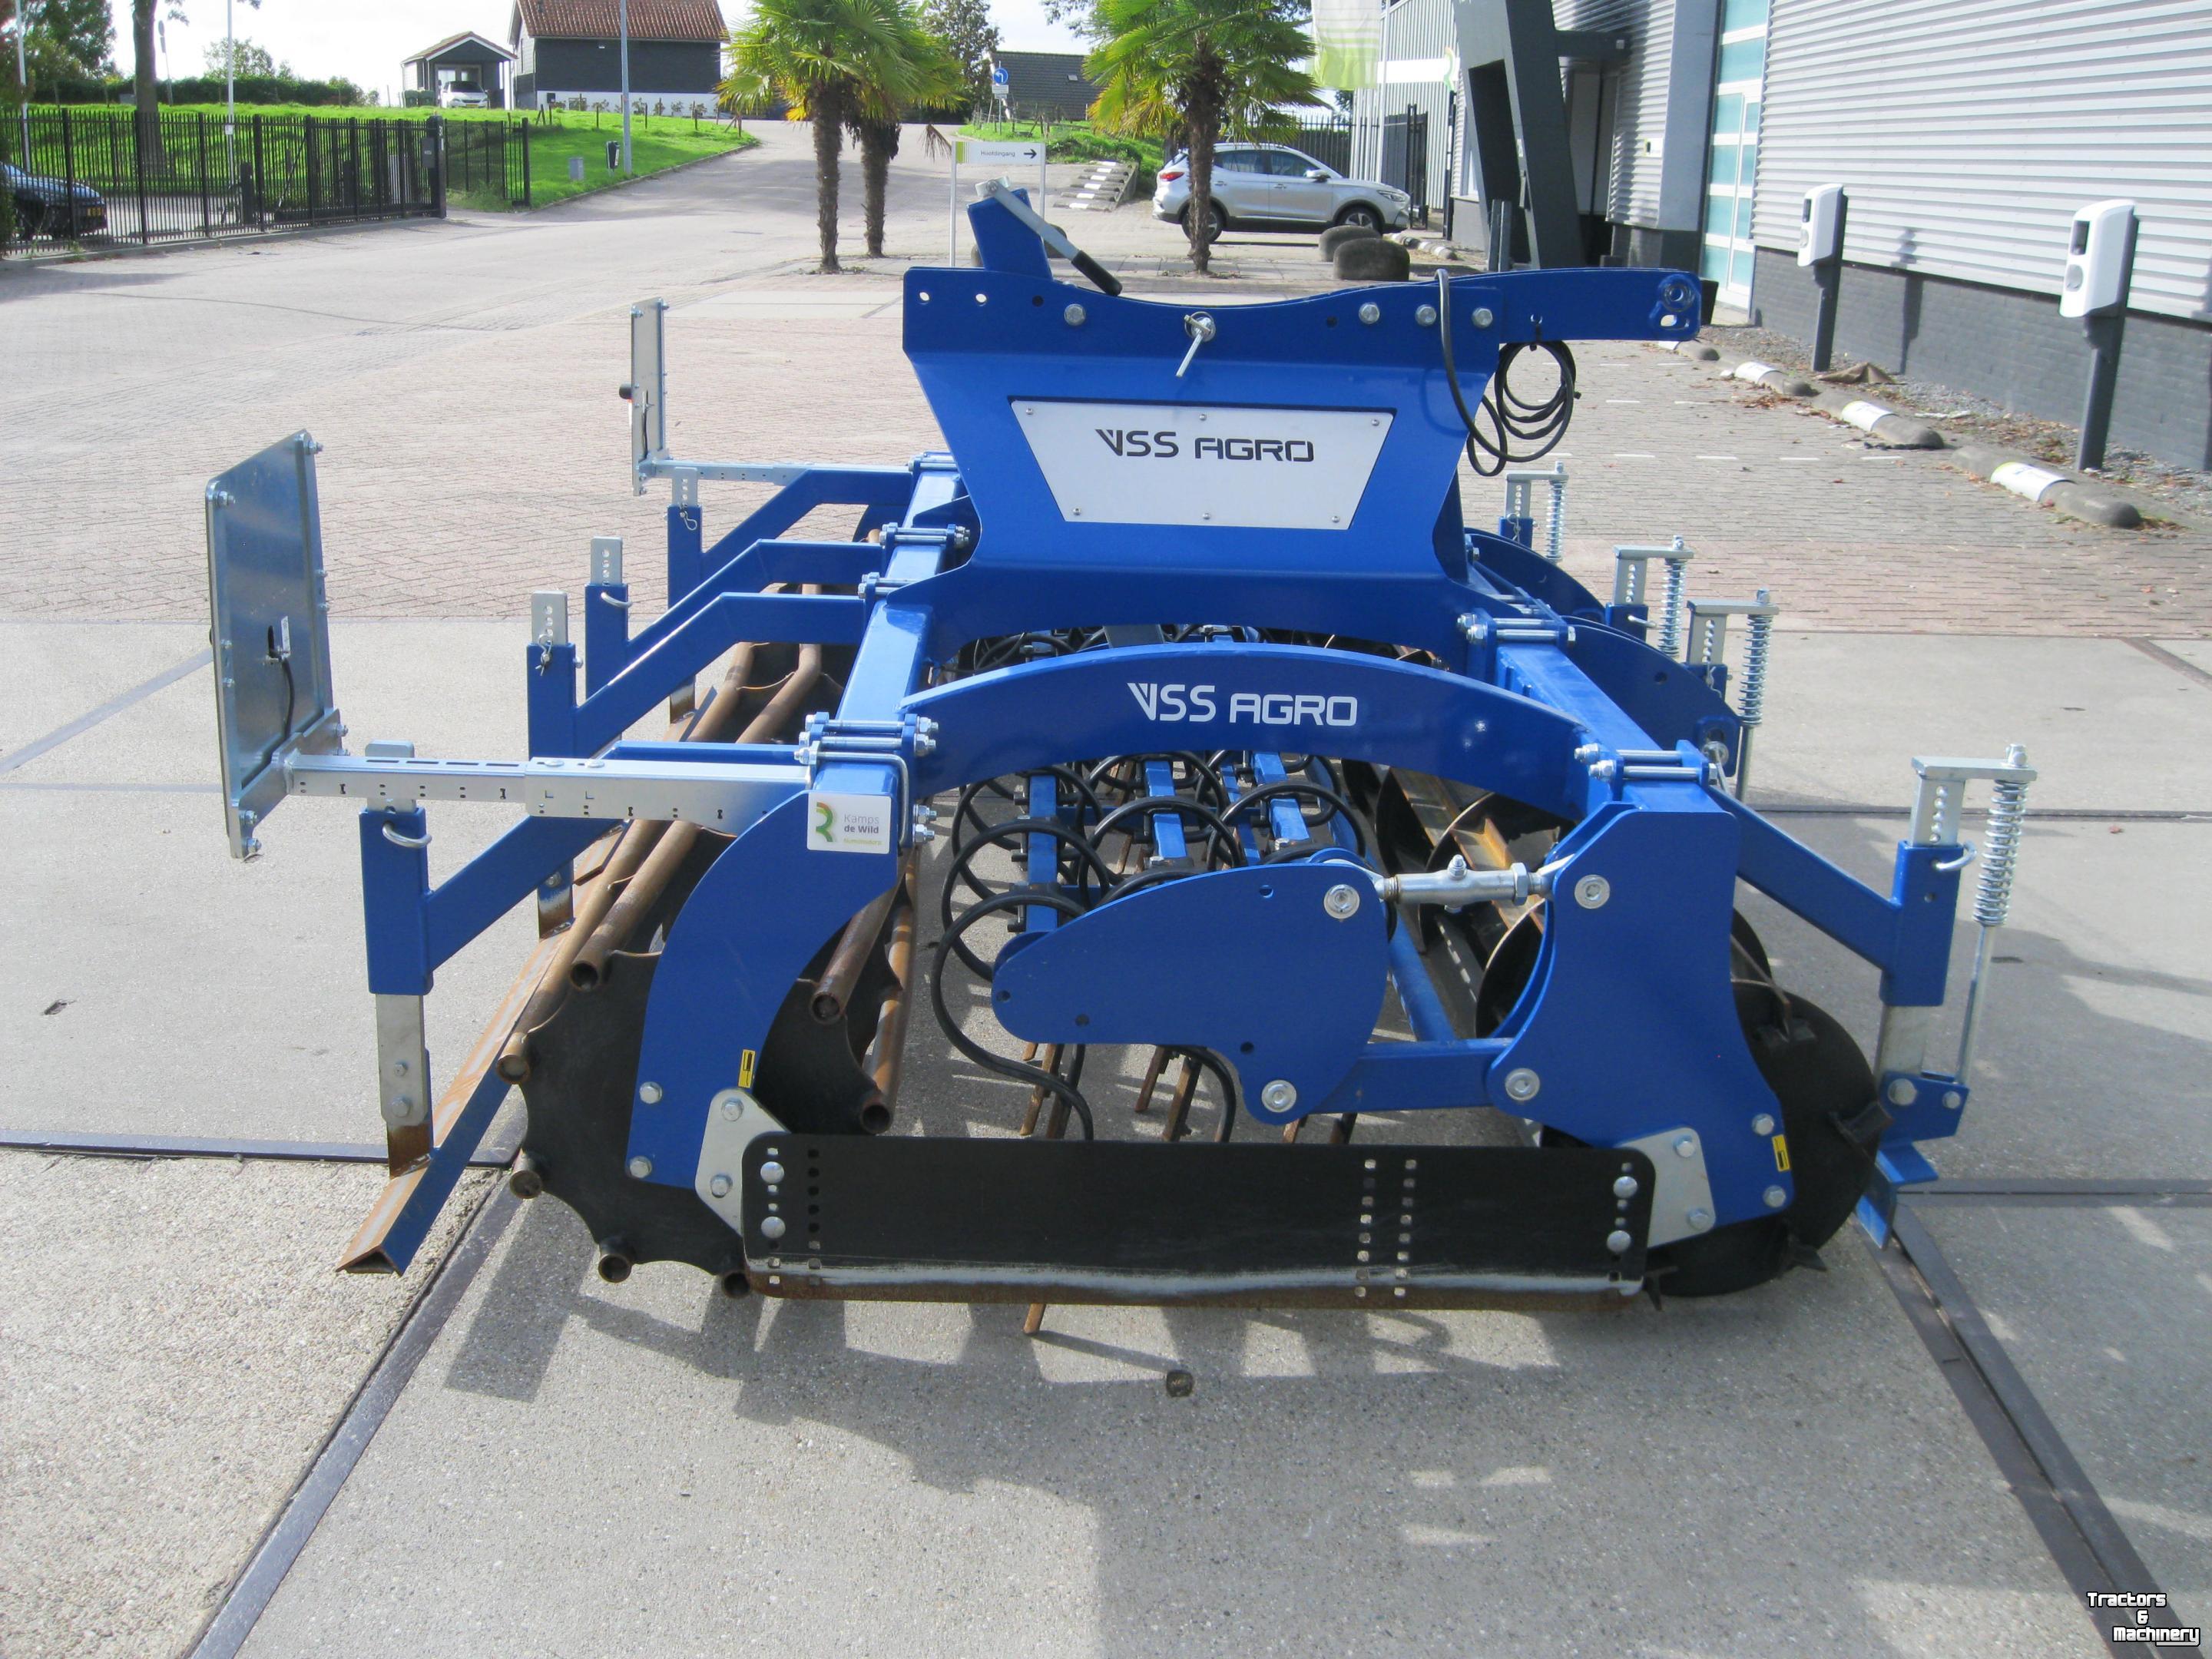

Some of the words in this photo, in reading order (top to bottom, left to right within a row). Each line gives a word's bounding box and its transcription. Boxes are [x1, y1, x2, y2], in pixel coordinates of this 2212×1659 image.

[1095, 429, 1179, 458] VSS
[1194, 437, 1314, 462] AGRO
[1127, 682, 1217, 722] VSS
[1229, 693, 1358, 727] AGRO
[844, 814, 879, 825] Kamps
[844, 824, 855, 833] de
[858, 825, 879, 833] Wild
